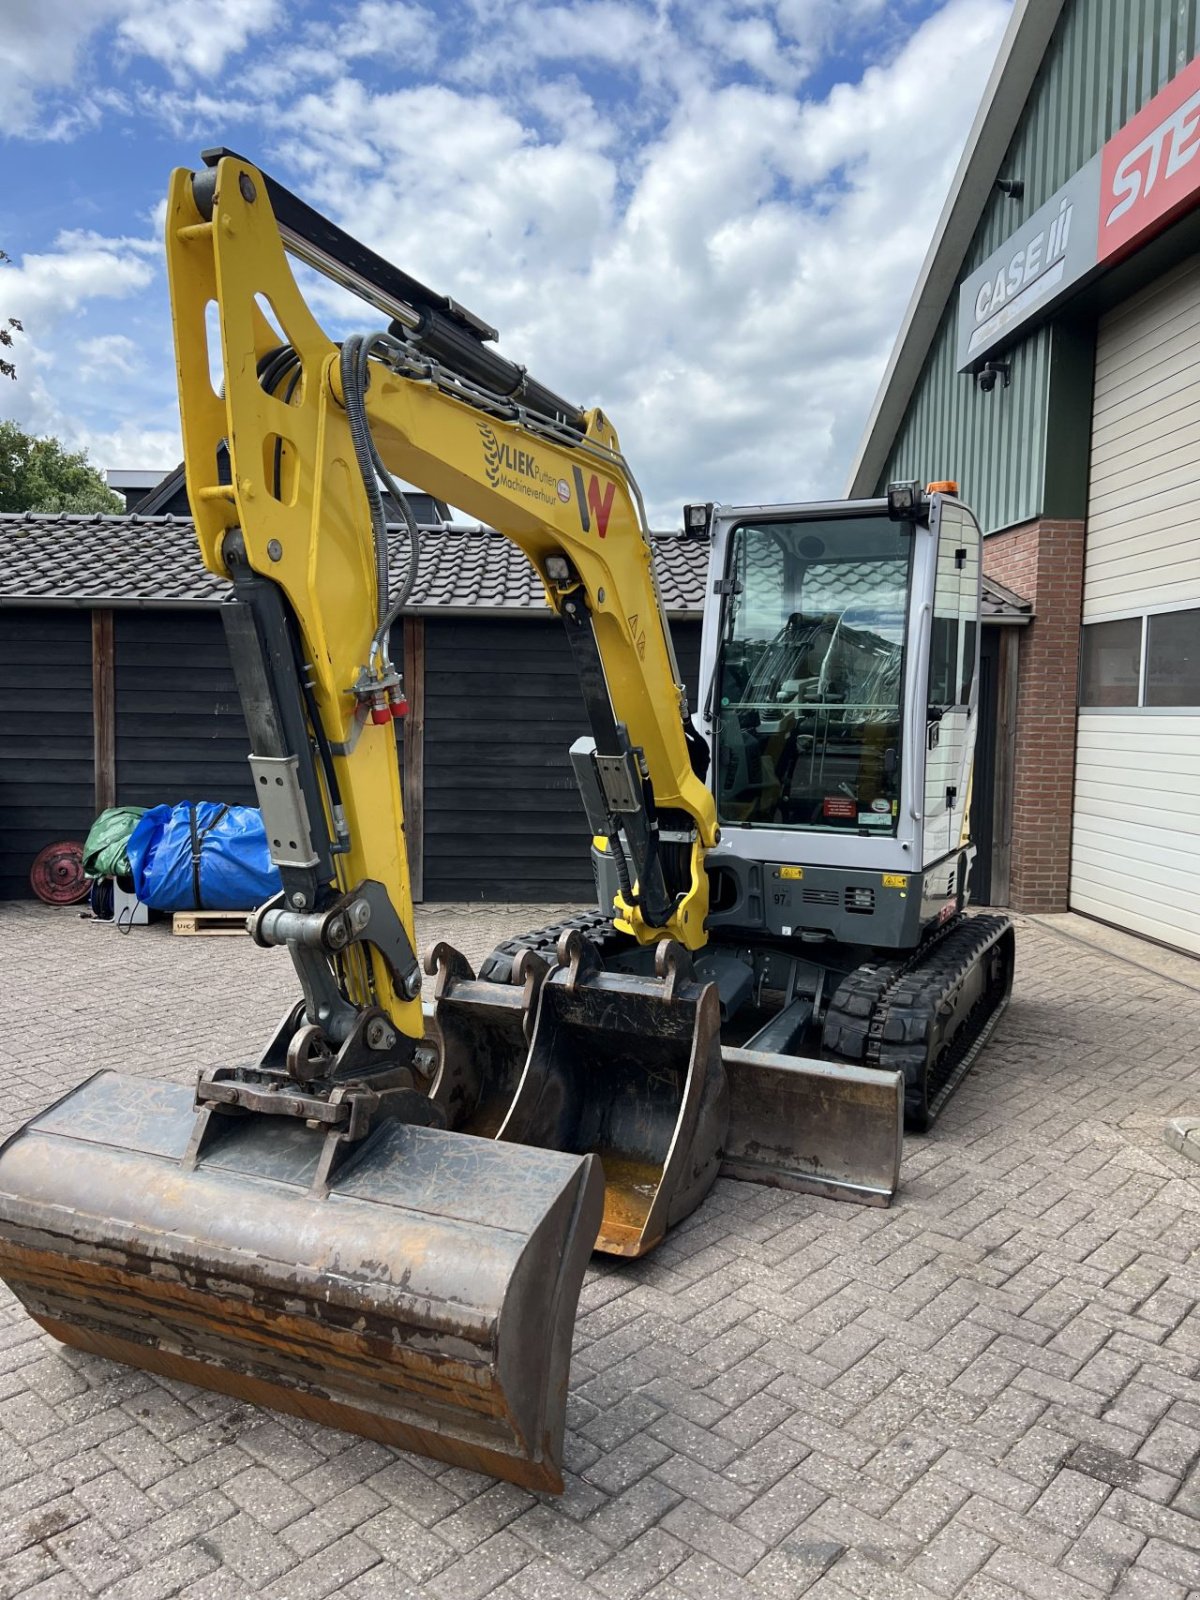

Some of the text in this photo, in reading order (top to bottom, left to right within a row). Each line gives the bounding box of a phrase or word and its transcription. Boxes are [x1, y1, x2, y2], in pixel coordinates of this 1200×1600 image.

[975, 232, 1044, 323] CASE
[497, 442, 557, 488] VLIEK Putten
[500, 473, 557, 505] Machineverhuur
[774, 893, 786, 906] 97
